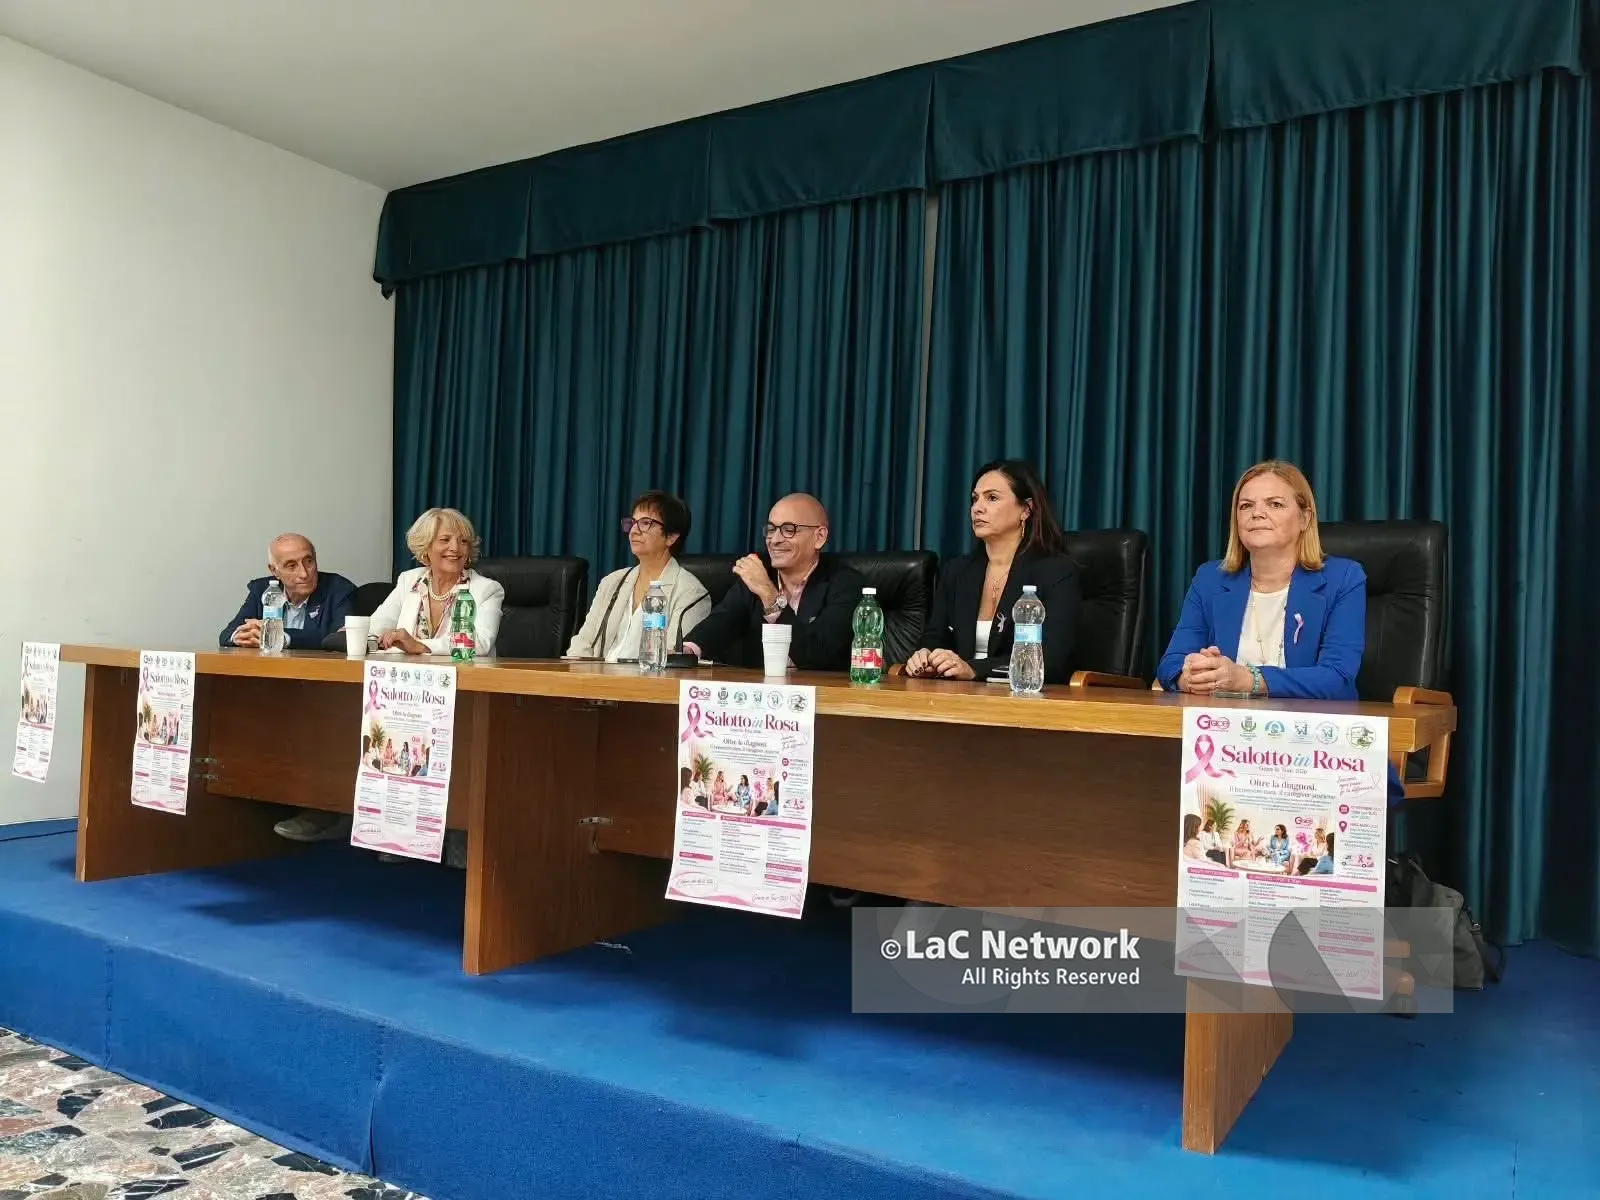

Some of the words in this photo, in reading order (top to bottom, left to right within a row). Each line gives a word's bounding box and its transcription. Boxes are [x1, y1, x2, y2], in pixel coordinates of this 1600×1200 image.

[705, 710, 752, 728] Salotto
[765, 714, 799, 732] Rosa
[1221, 744, 1293, 767] Salotto
[1293, 753, 1312, 767] in
[1313, 750, 1367, 773] Rosa
[1249, 779, 1270, 789] Oltre
